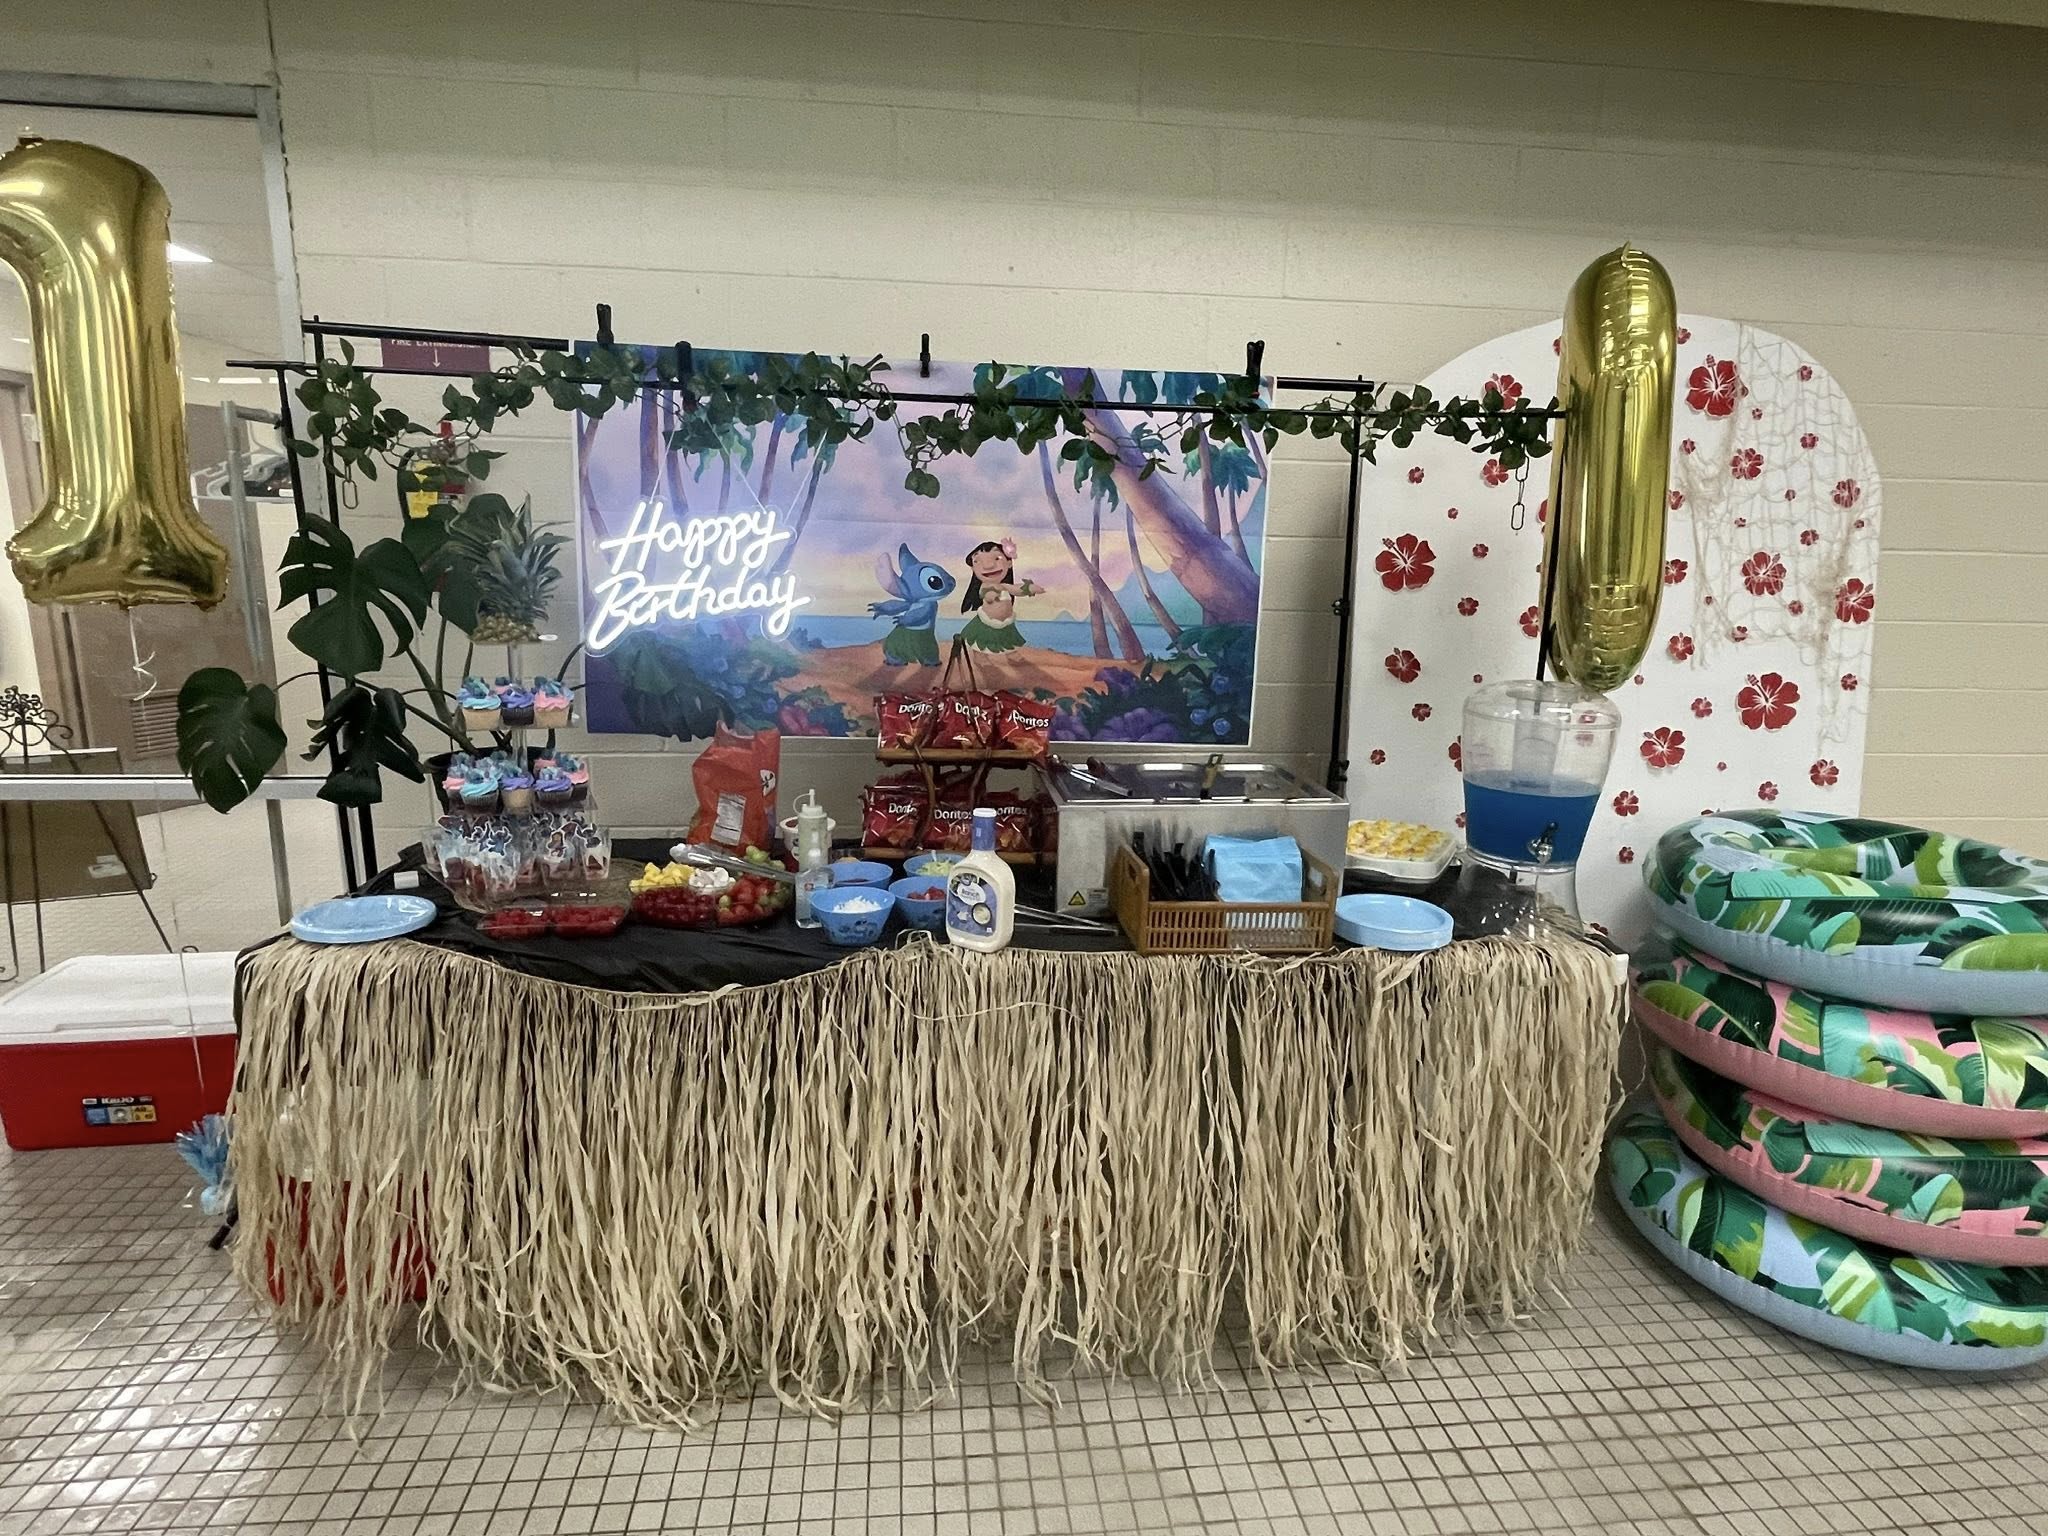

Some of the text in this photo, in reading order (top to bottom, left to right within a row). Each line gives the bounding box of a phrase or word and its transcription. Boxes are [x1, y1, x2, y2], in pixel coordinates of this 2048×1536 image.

[599, 501, 792, 575] Happy
[587, 564, 811, 650] Birthday
[1012, 709, 1049, 728] Doritos
[996, 806, 1028, 816] oritos
